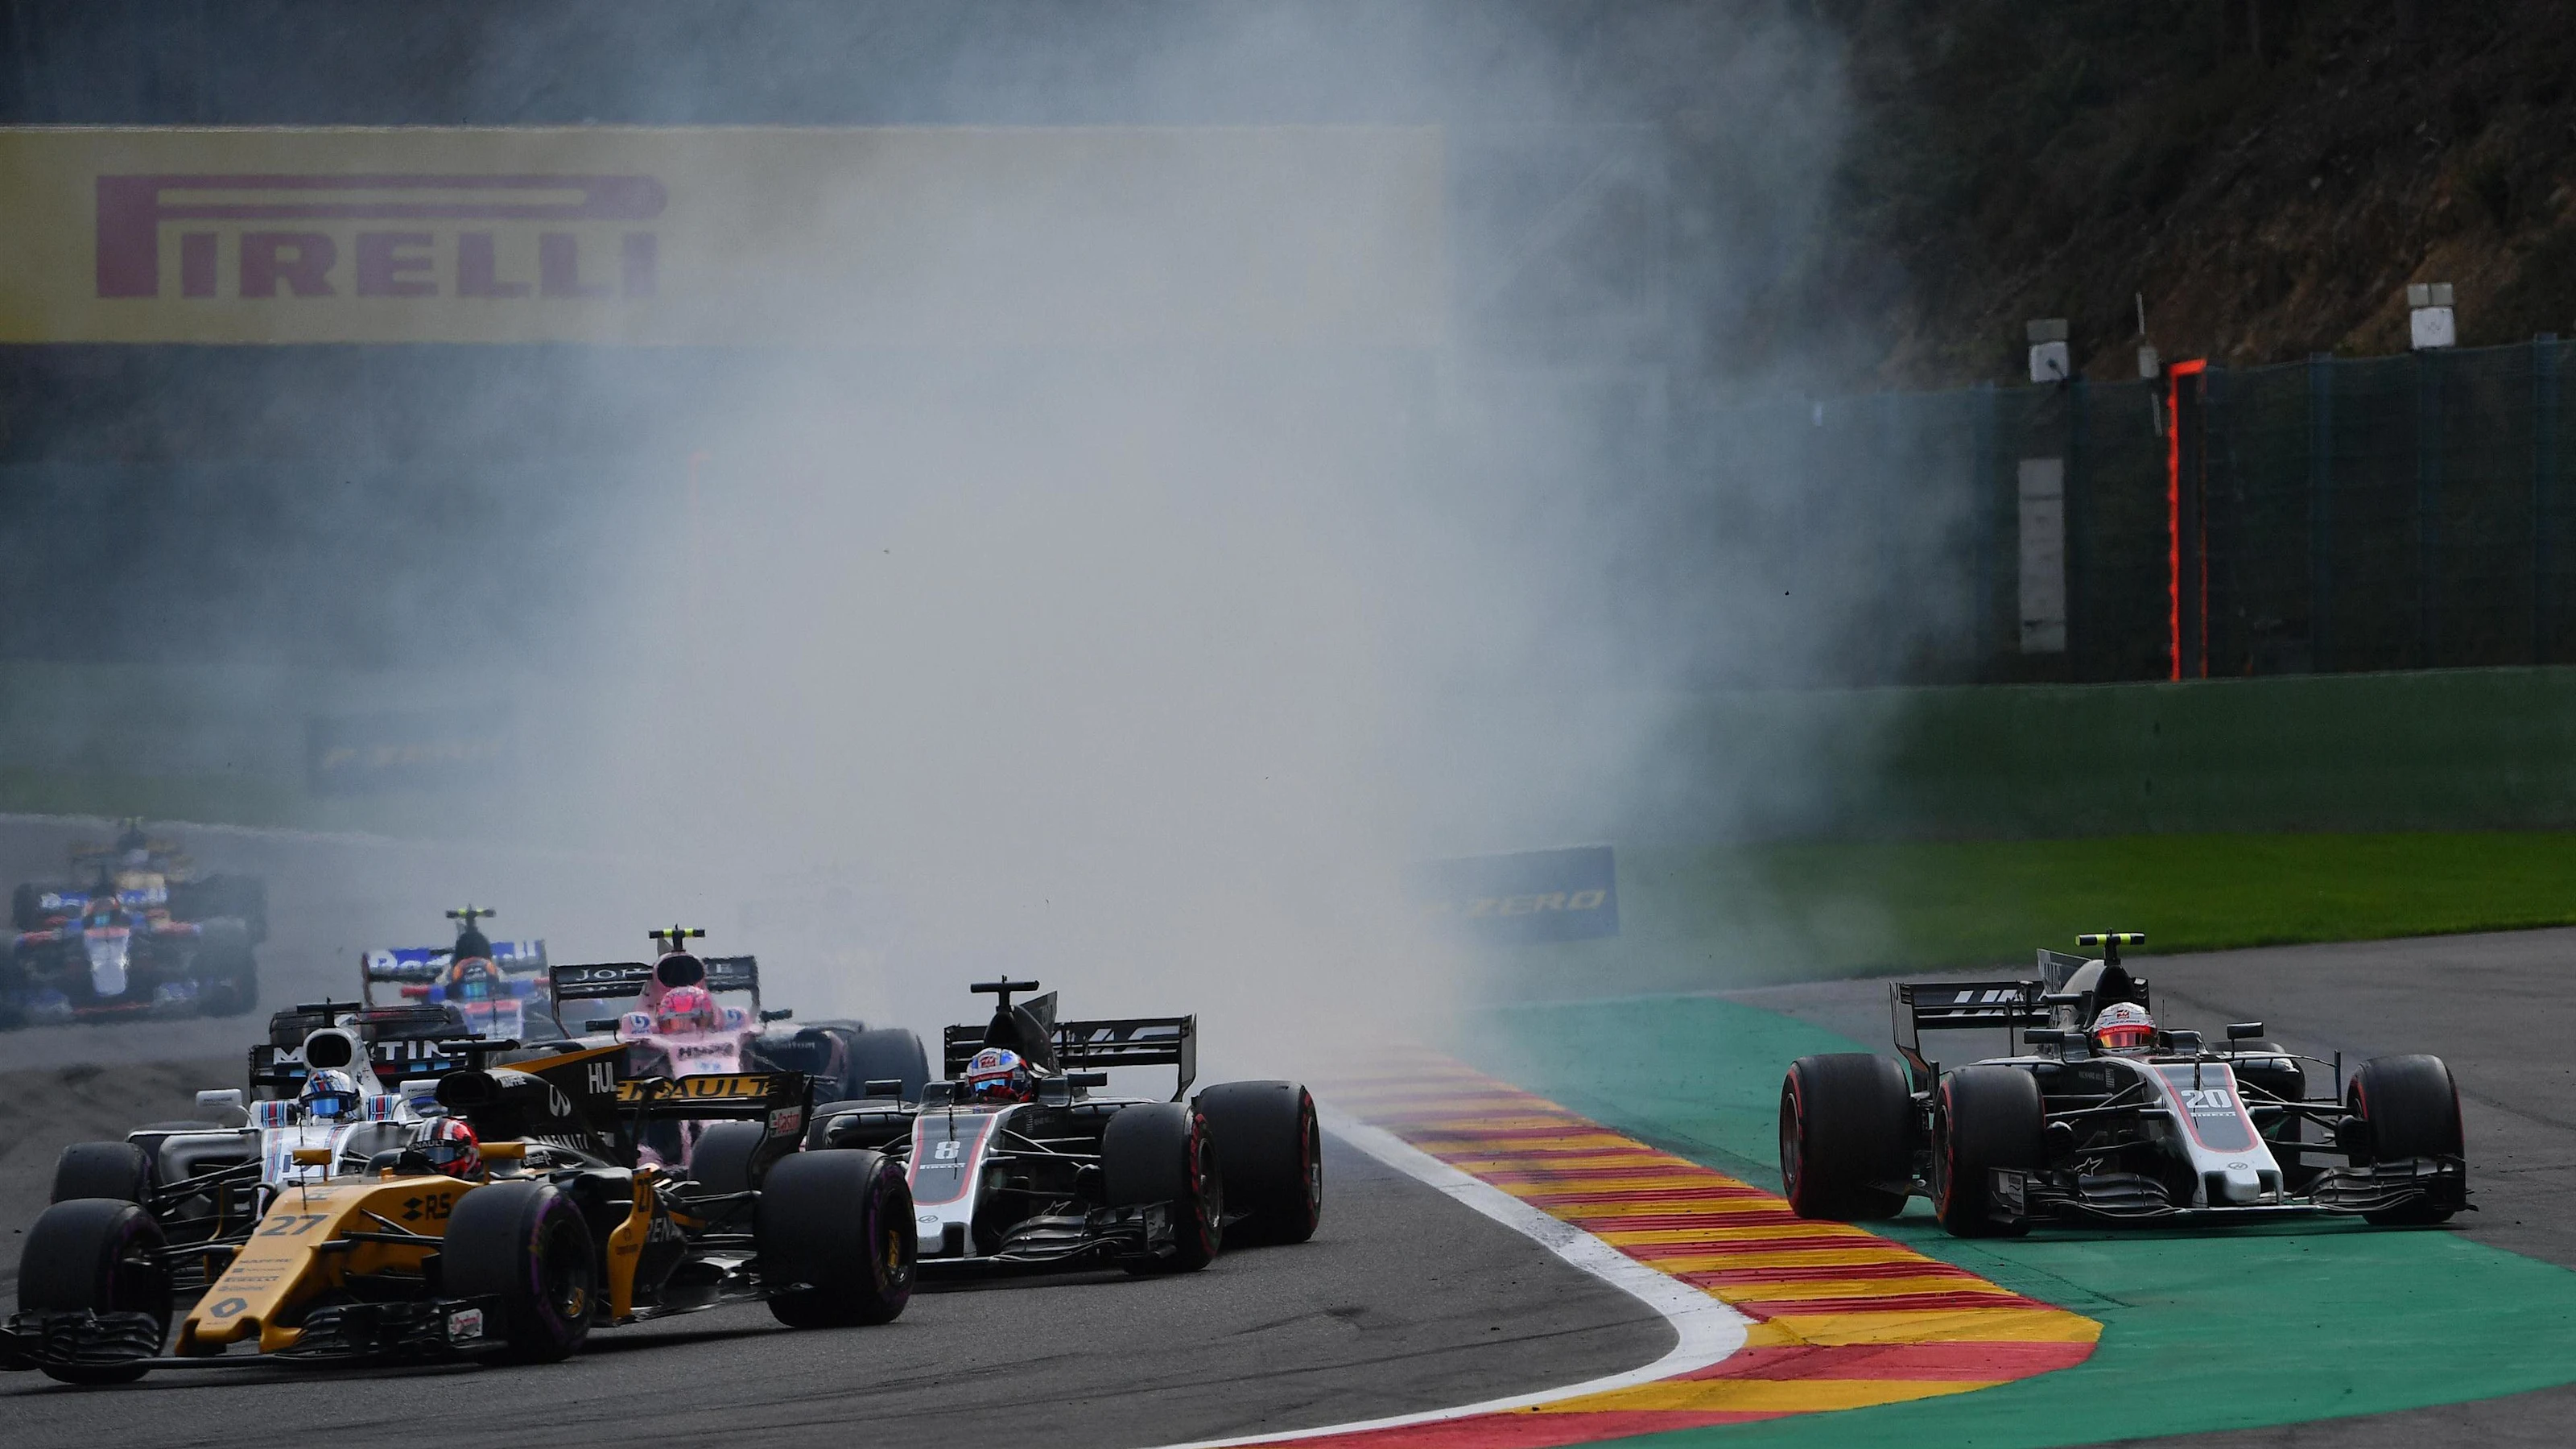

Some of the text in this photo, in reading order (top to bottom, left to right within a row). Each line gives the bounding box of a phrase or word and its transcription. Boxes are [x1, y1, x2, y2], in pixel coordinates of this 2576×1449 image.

[96, 174, 668, 299] PIRELLI
[588, 1061, 618, 1094] HUL
[2181, 1089, 2233, 1108] 20
[935, 1141, 961, 1160] 8
[425, 1192, 452, 1220] RS
[258, 1214, 328, 1236] 27
